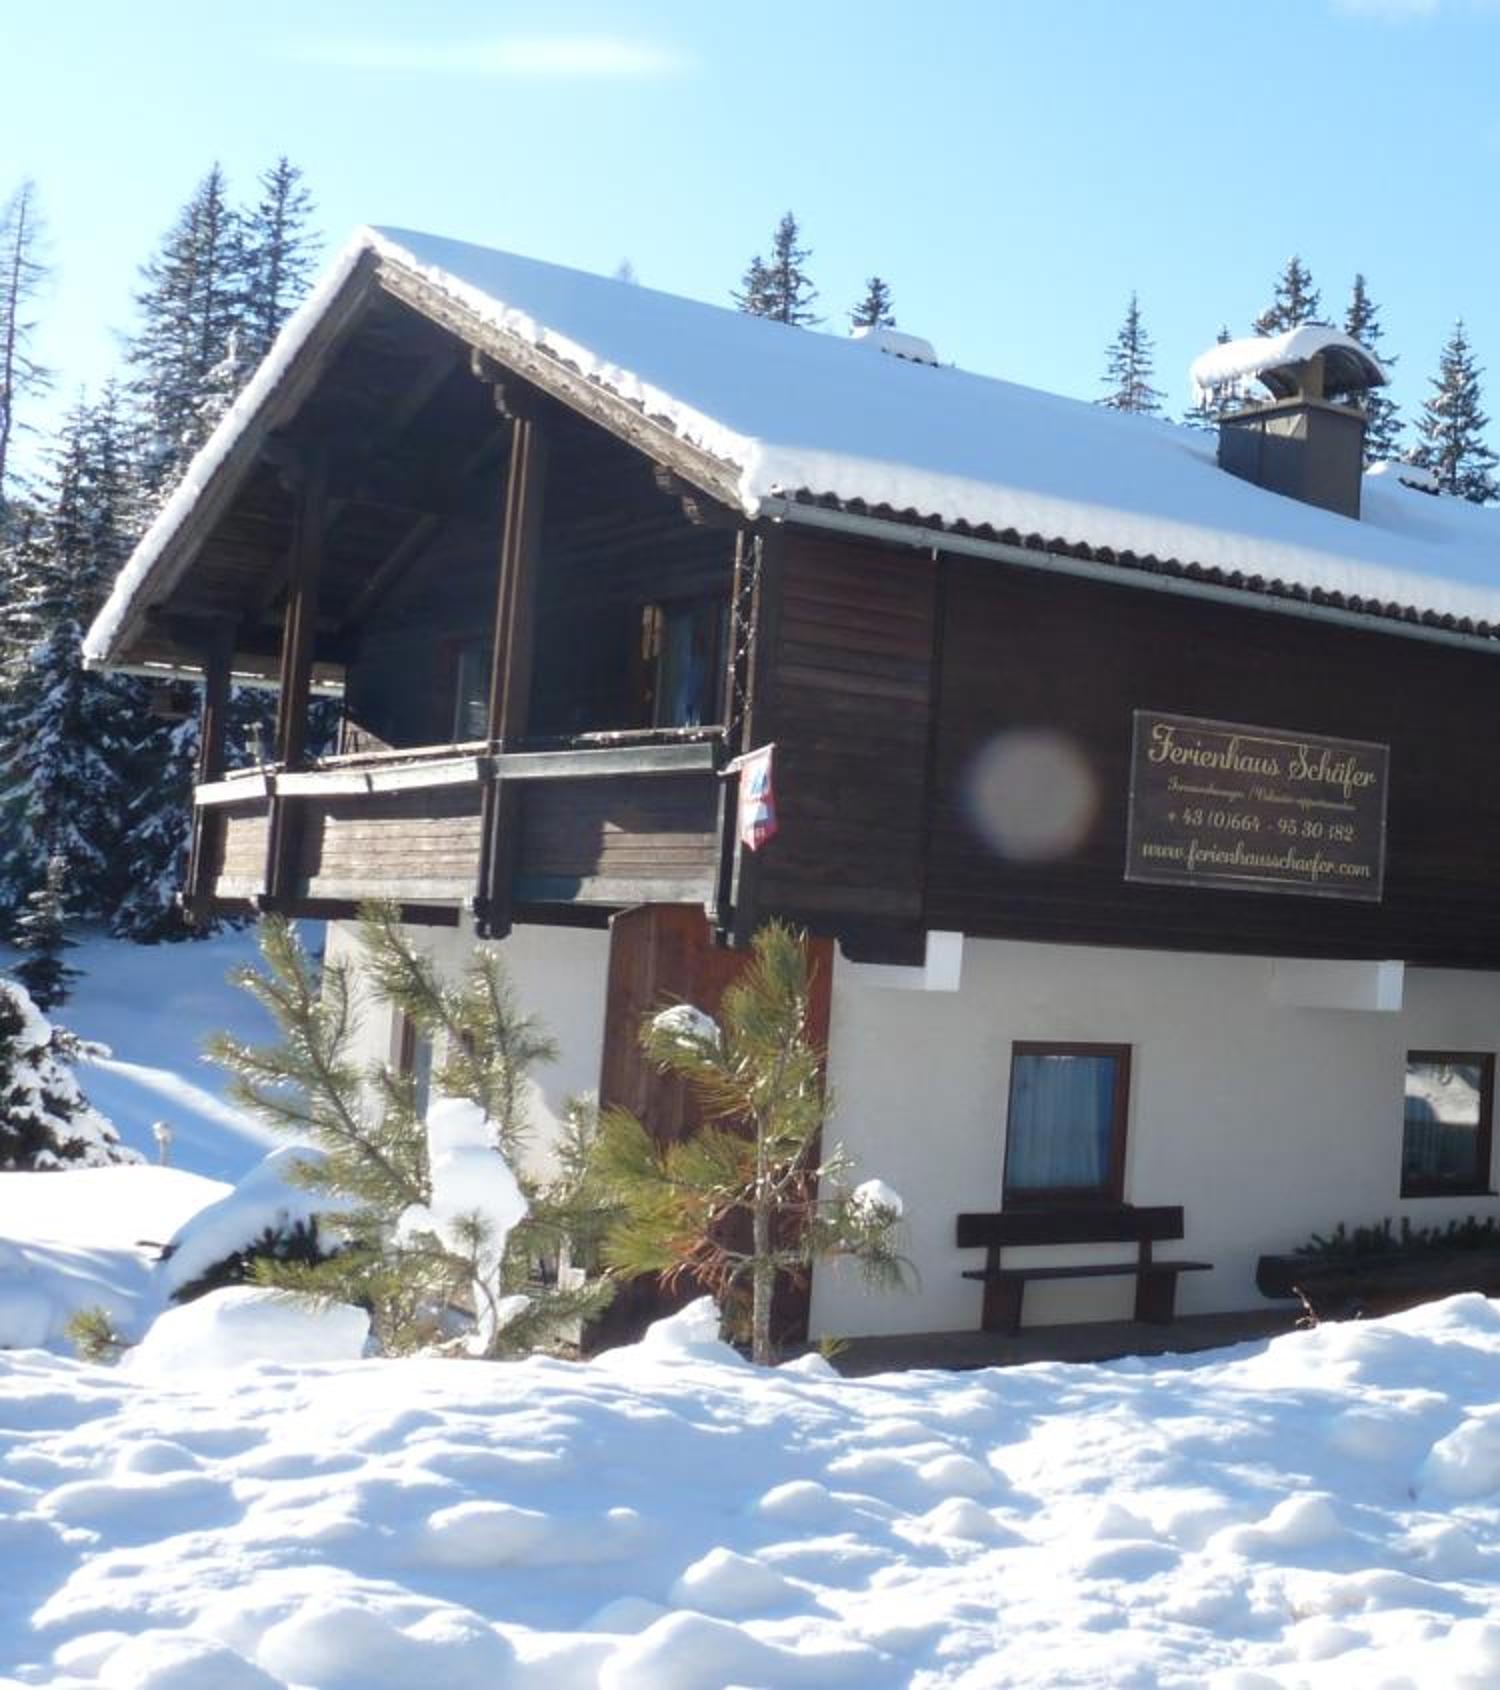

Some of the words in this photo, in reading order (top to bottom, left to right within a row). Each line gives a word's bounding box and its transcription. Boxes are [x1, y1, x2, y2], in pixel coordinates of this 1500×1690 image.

[1148, 723, 1280, 776] Ferienhaus
[1288, 742, 1376, 798] Schäfer
[1182, 807, 1202, 826] 43
[1278, 818, 1297, 836] 95
[1302, 821, 1323, 839] 30
